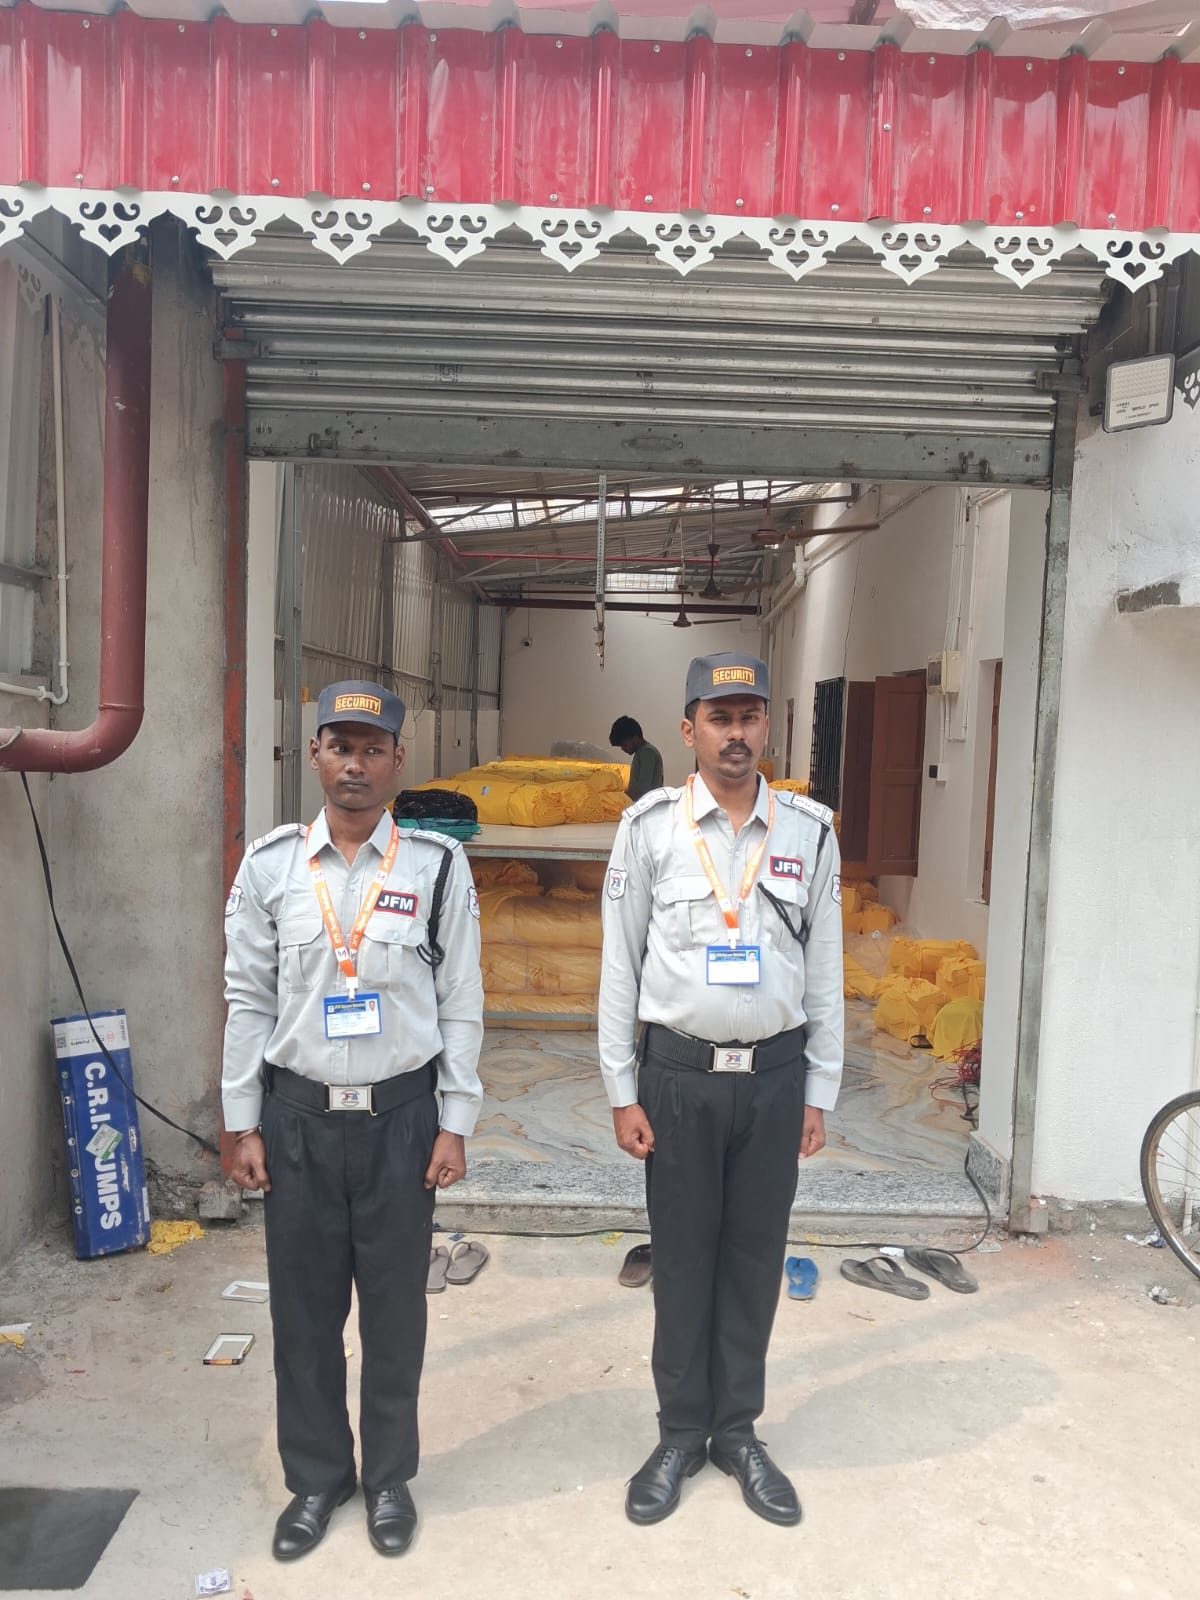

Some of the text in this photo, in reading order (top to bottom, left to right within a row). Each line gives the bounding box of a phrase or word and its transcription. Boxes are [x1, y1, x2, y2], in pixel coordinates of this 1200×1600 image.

[714, 669, 753, 682] SECURITY
[336, 696, 379, 711] SECURITY
[378, 894, 414, 911] JFM
[84, 1061, 111, 1130] C.R.I.
[94, 1149, 122, 1230] UMPS
